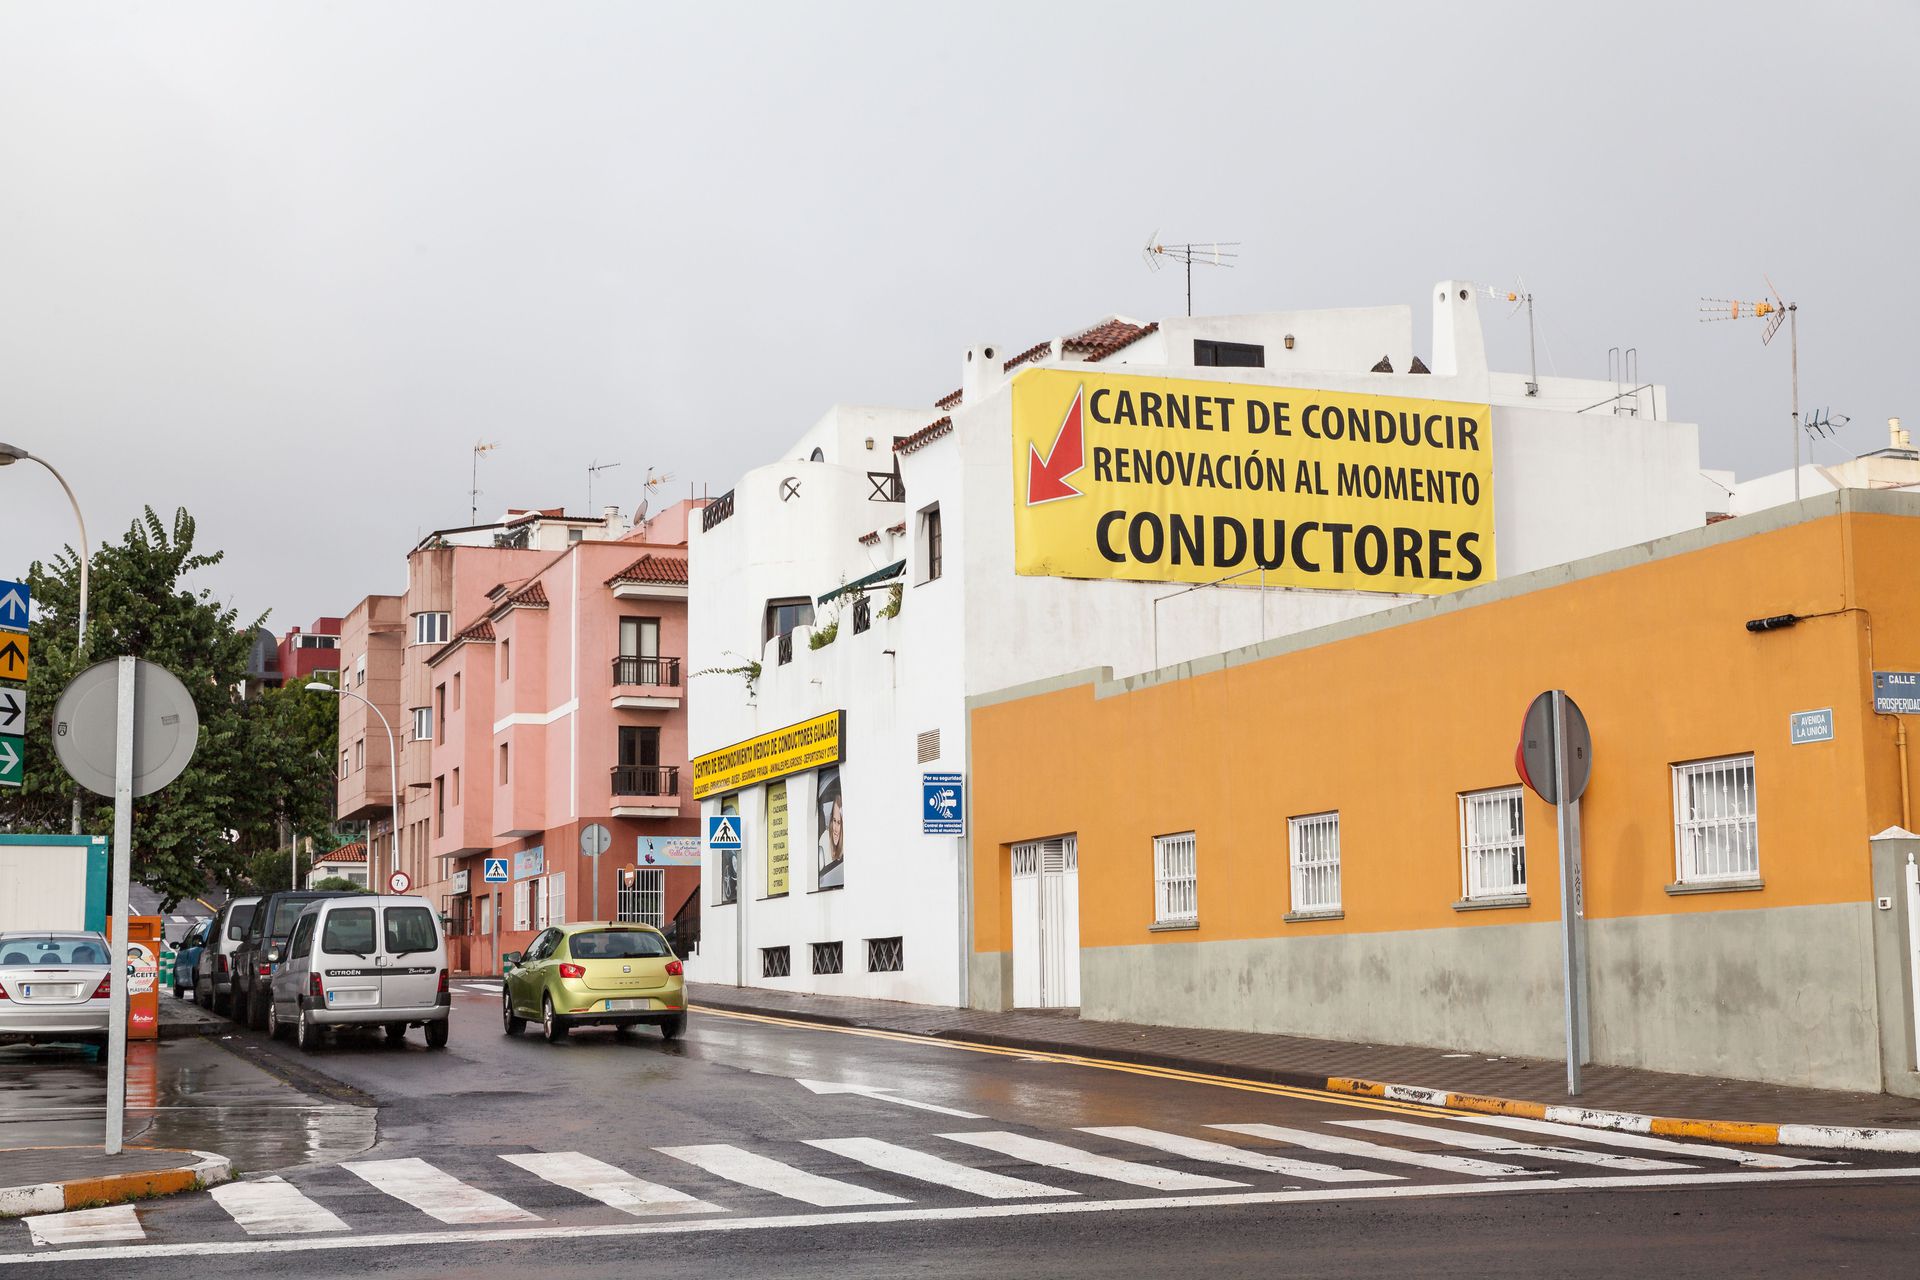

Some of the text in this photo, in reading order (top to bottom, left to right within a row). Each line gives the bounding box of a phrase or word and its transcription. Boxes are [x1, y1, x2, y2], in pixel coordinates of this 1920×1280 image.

[1090, 389, 1480, 451] CARNET DE CONDUCIR
[1094, 447, 1480, 506] RENOVACIÓN AL MOMENTO
[1096, 510, 1482, 582] CONDUCTORES
[1888, 674, 1916, 684] CALLE
[695, 759, 710, 779] CENTRO
[711, 757, 716, 774] DE
[717, 745, 752, 772] RECONOCIMIENTO
[771, 737, 776, 756] DE
[778, 726, 812, 753] CONDUCTORES
[813, 718, 837, 743] GUAJARA
[1796, 724, 1828, 737] LA UNIÓN
[1800, 714, 1826, 726] AVENIDA
